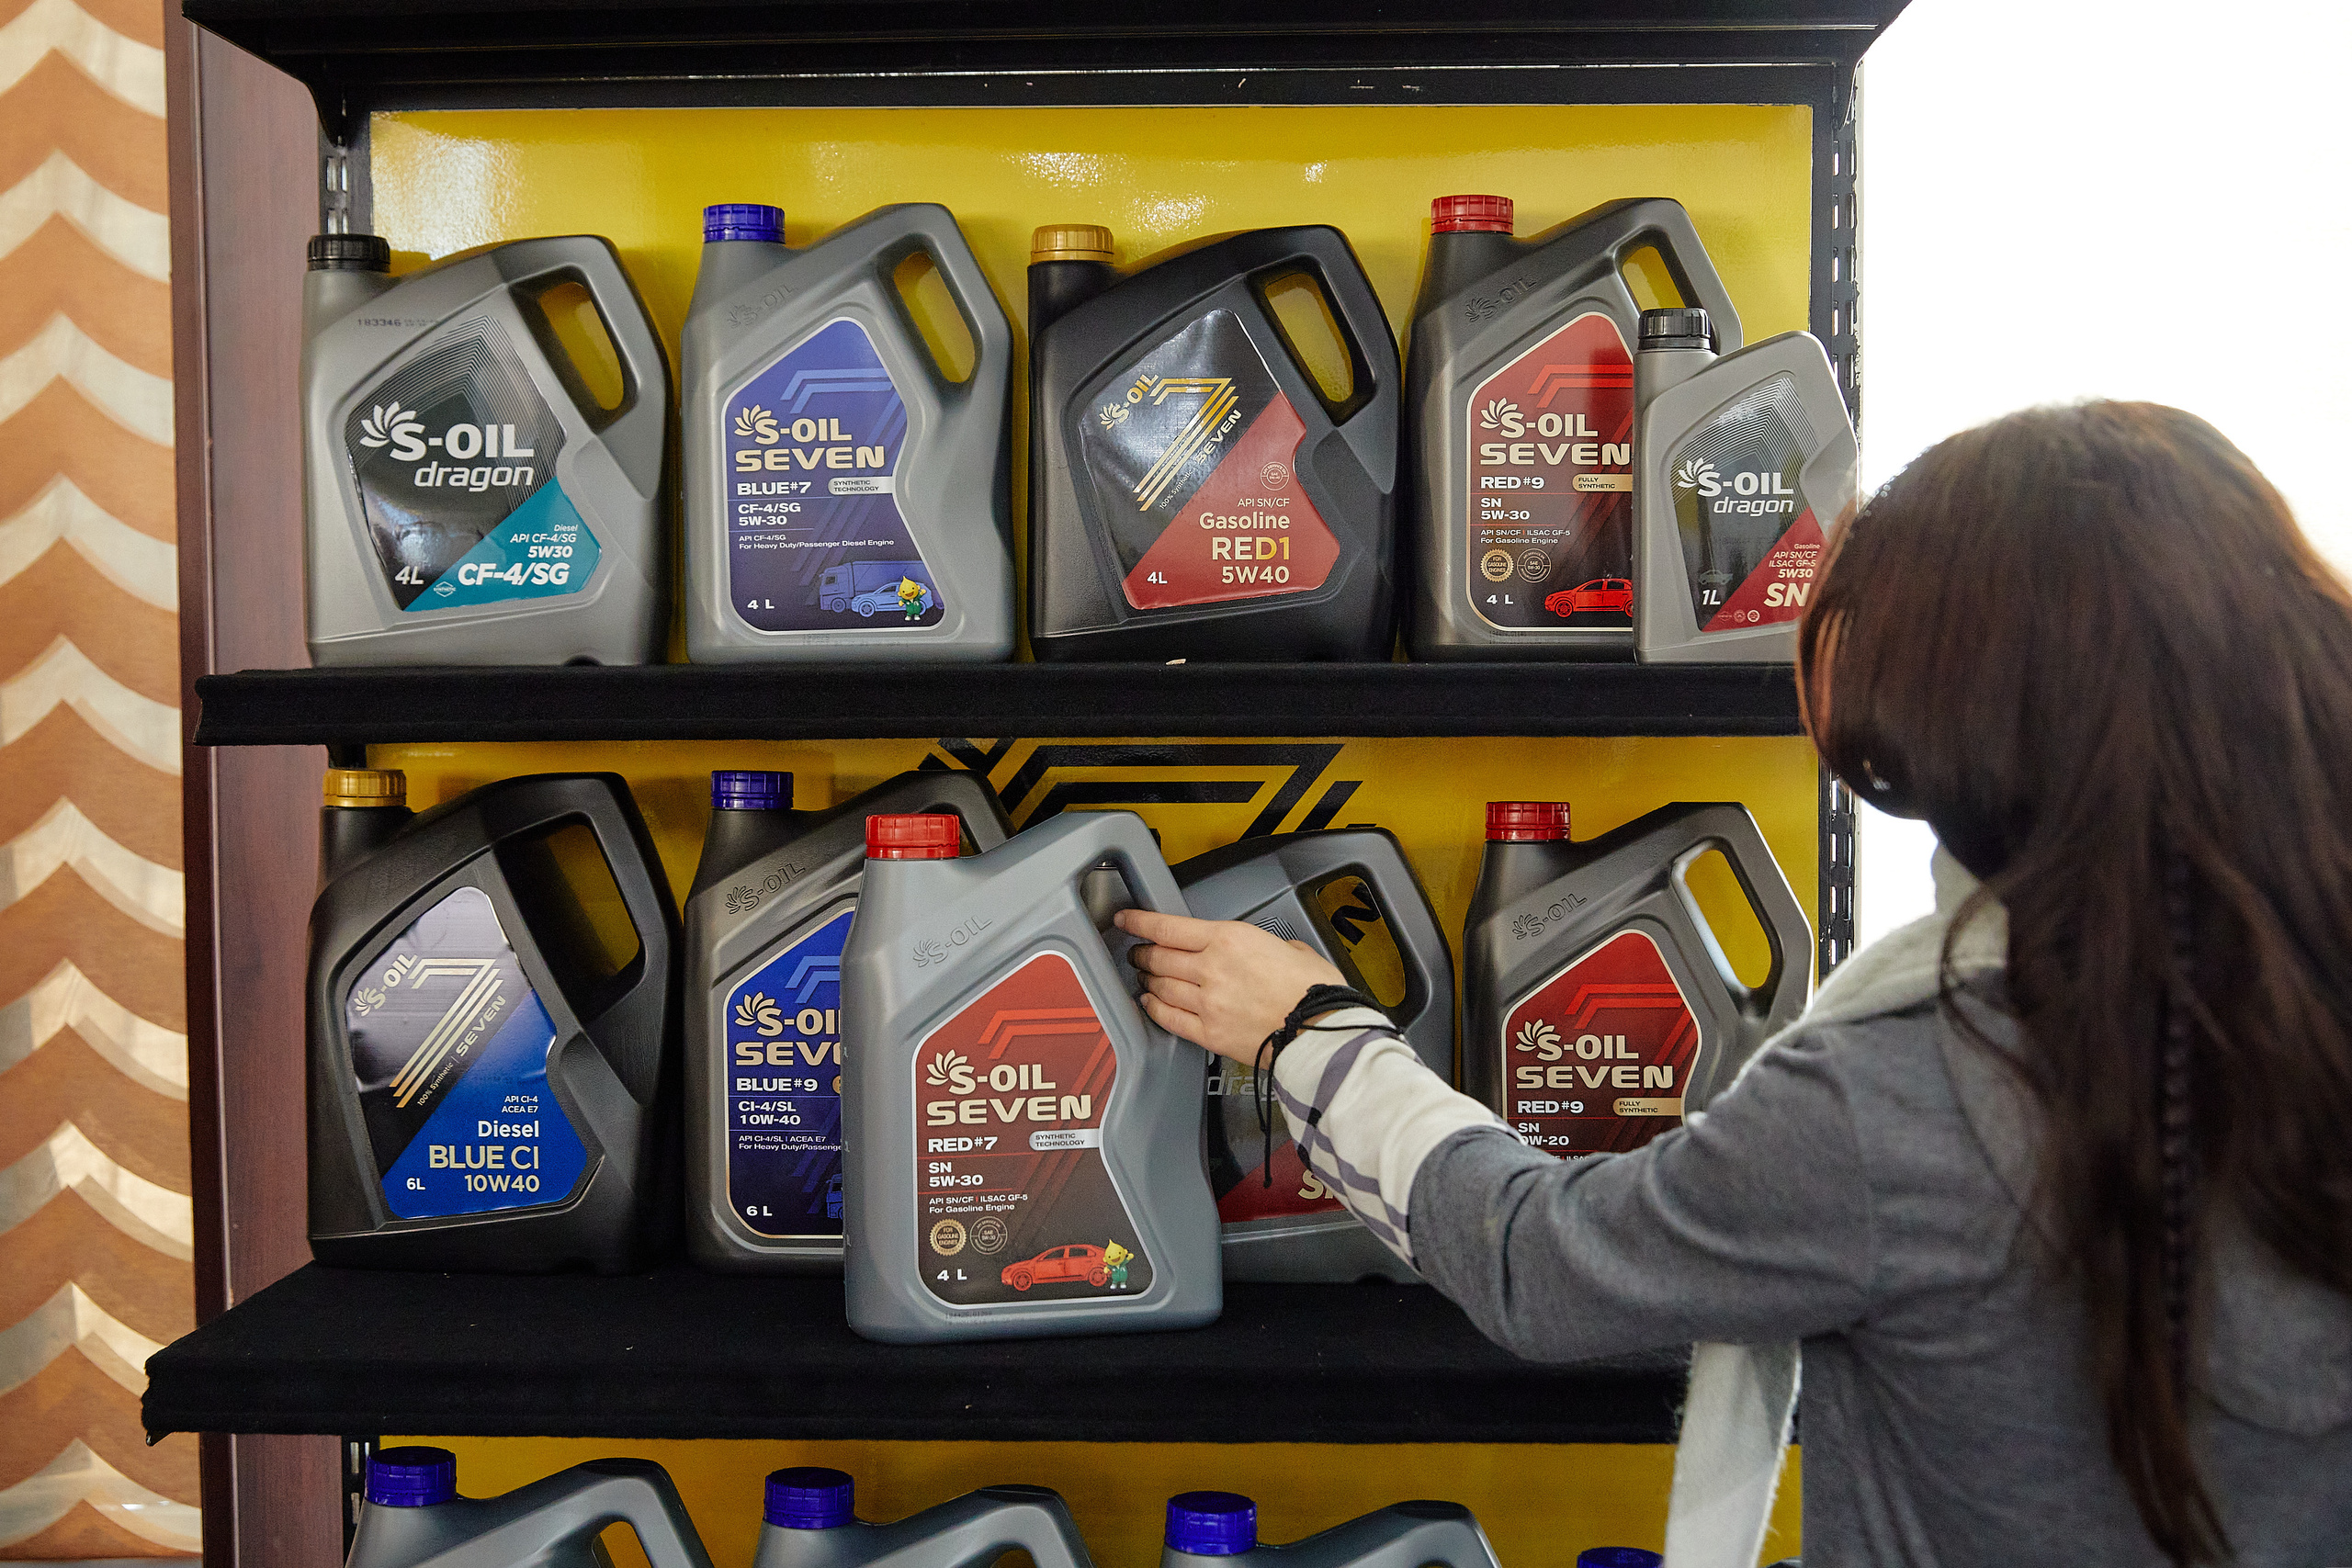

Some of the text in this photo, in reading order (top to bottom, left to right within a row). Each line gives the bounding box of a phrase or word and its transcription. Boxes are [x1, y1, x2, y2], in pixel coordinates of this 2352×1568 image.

[1479, 277, 1537, 320] S-OIL
[1112, 373, 1159, 423] S-OIL
[755, 418, 853, 445] S-OIL
[1499, 413, 1599, 439] S-OIL
[390, 423, 535, 461] S-OIL
[1194, 410, 1242, 465] SEVEN
[735, 446, 884, 472] SEVEN
[1479, 443, 1630, 465] SEVEN
[414, 461, 535, 492] dragon
[1697, 471, 1793, 497] S-OIL
[737, 481, 812, 496] BLUE#7
[1159, 470, 1193, 509] 100% Synthetic
[739, 503, 801, 514] CF-4/SG
[1238, 498, 1290, 508] API SN/CF
[1481, 498, 1502, 508] SN
[1713, 496, 1793, 517] dragon
[739, 516, 787, 526] 5W-30
[1199, 511, 1290, 529] Gasoline
[1481, 511, 1531, 520] 5W-30
[511, 534, 577, 543] API CF-4/SG
[779, 541, 840, 549] Duty/Passenger
[1532, 537, 1558, 546] Engine
[527, 546, 573, 558] 5W30
[1213, 536, 1290, 560] RED1
[395, 566, 424, 584] 4L
[458, 562, 570, 586] CF-4/SG
[1147, 571, 1168, 584] 4L
[1222, 566, 1290, 584] 5W40
[1778, 569, 1814, 579] 5W30
[1487, 594, 1514, 604] 4 L
[1702, 590, 1721, 605] 1L
[1764, 582, 1811, 607] SN
[748, 599, 775, 610] 4 L
[740, 863, 805, 911] S-OIL
[1526, 893, 1588, 937] S-OIL
[928, 917, 992, 964] S-OIL
[368, 953, 418, 1010] S-OIL
[456, 995, 506, 1056] SEVEN
[757, 1008, 840, 1036] S-OI
[1536, 1034, 1639, 1061] S-OIL
[417, 1062, 454, 1106] 100% Synthetic
[948, 1064, 1057, 1095] S-OIL
[1516, 1066, 1673, 1089] SEVEN
[739, 1100, 796, 1111] CI-4/SL
[926, 1095, 1091, 1126] SEVEN
[741, 1115, 801, 1124] 10W-40
[1518, 1122, 1540, 1134] SN
[478, 1121, 538, 1137] Diesel
[928, 1137, 998, 1153] RED#7
[429, 1145, 538, 1169] BLUE CI
[928, 1162, 952, 1174] SN
[406, 1178, 426, 1190] 6L
[465, 1174, 540, 1192] 10W40
[929, 1175, 983, 1188] 5W-30
[1297, 1169, 1334, 1200] S
[946, 1196, 974, 1204] SN/CF
[980, 1195, 1005, 1203] ILSAC
[985, 1203, 1014, 1213] Engine
[746, 1206, 773, 1216] 6 L
[937, 1269, 967, 1280] 4 L
